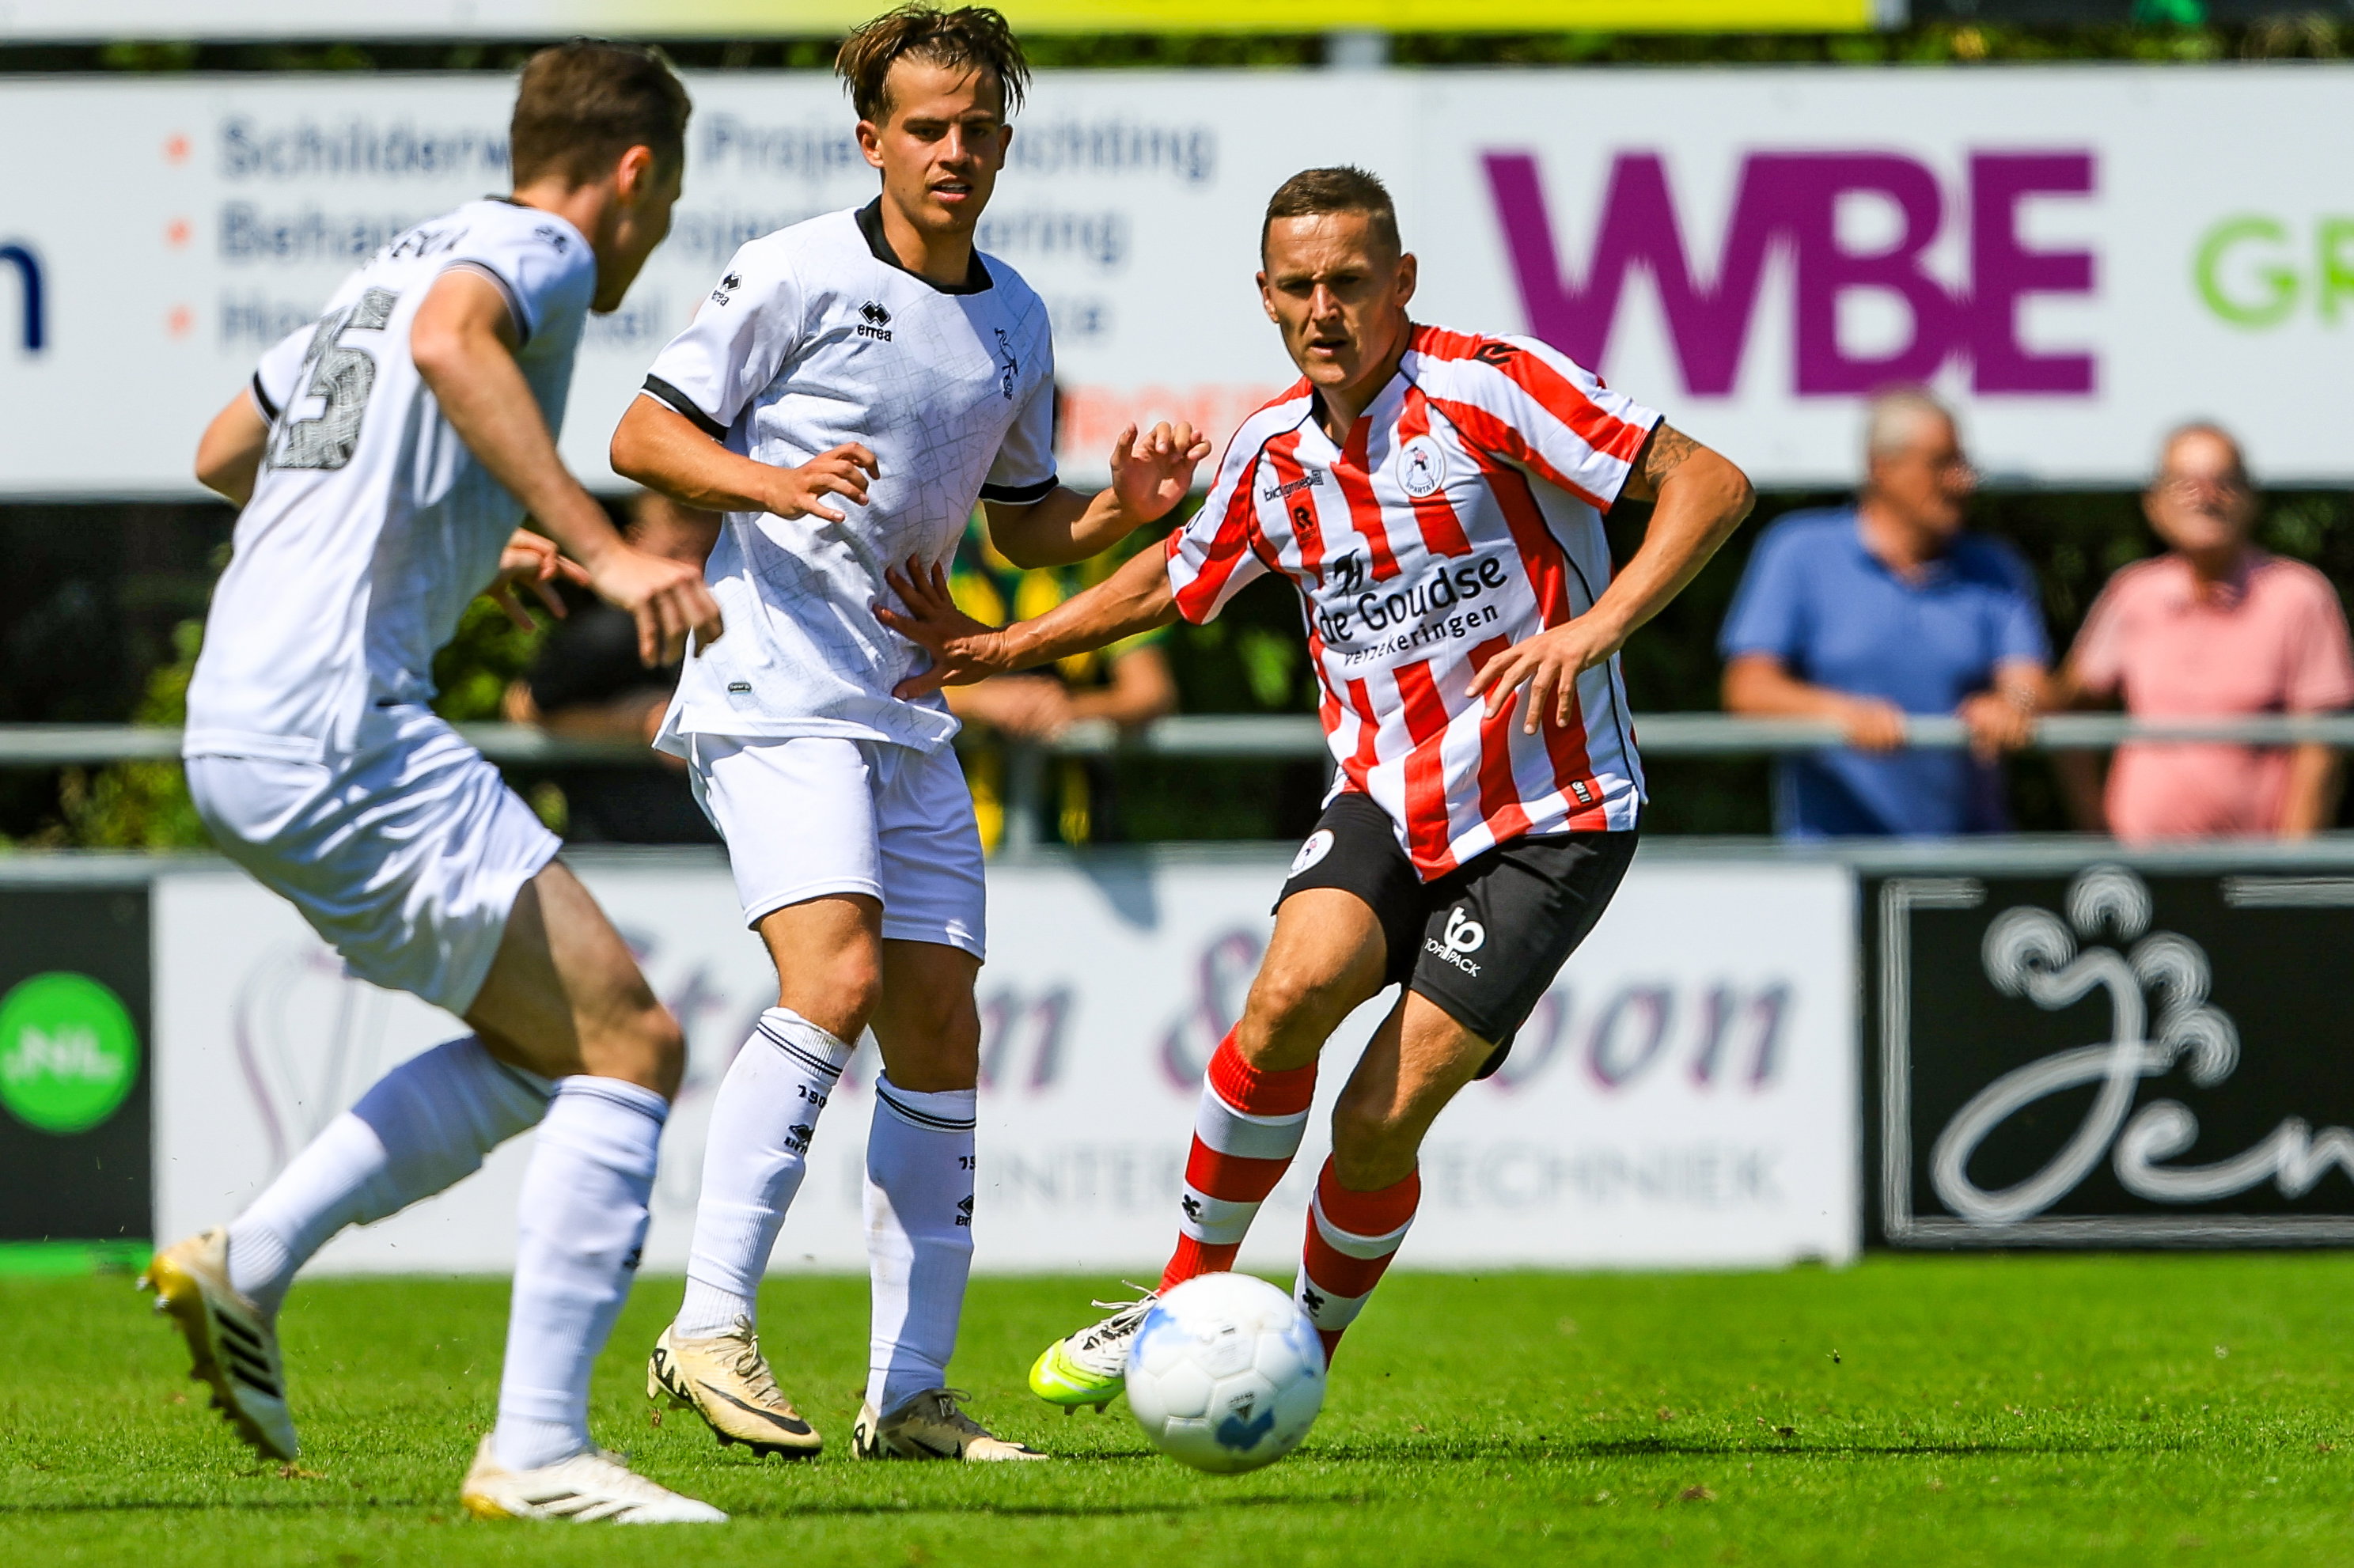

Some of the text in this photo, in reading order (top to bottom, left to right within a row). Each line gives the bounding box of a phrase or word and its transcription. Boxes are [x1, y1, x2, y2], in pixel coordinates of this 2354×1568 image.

[1476, 146, 2098, 399] WBE
[857, 323, 892, 343] errea
[1319, 556, 1508, 644] de Goudse
